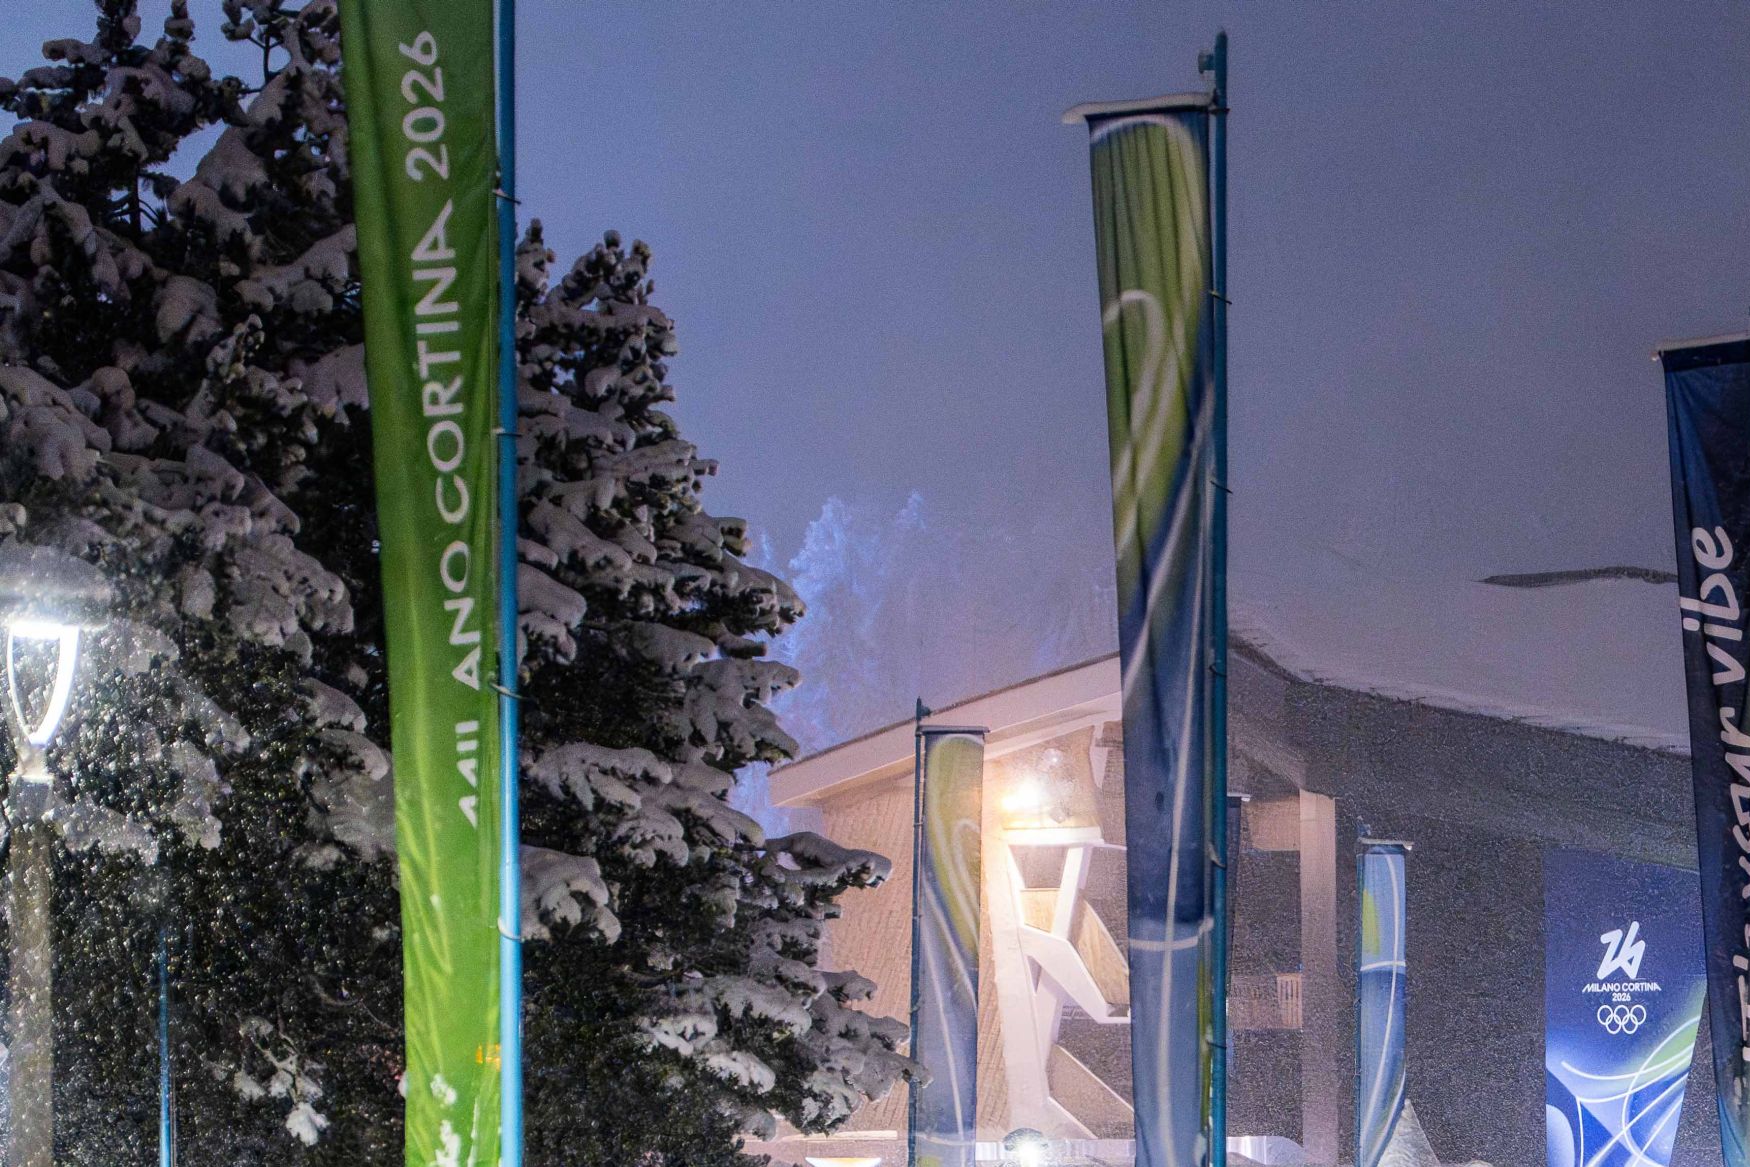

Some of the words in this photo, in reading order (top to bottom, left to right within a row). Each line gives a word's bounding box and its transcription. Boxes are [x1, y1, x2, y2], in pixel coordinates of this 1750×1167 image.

[398, 30, 449, 182] 2026
[411, 198, 470, 524] CORTINA
[1680, 526, 1746, 686] vibe
[1582, 982, 1620, 993] MILANO
[1621, 982, 1662, 992] CORTINA
[1612, 992, 1631, 1002] 2026
